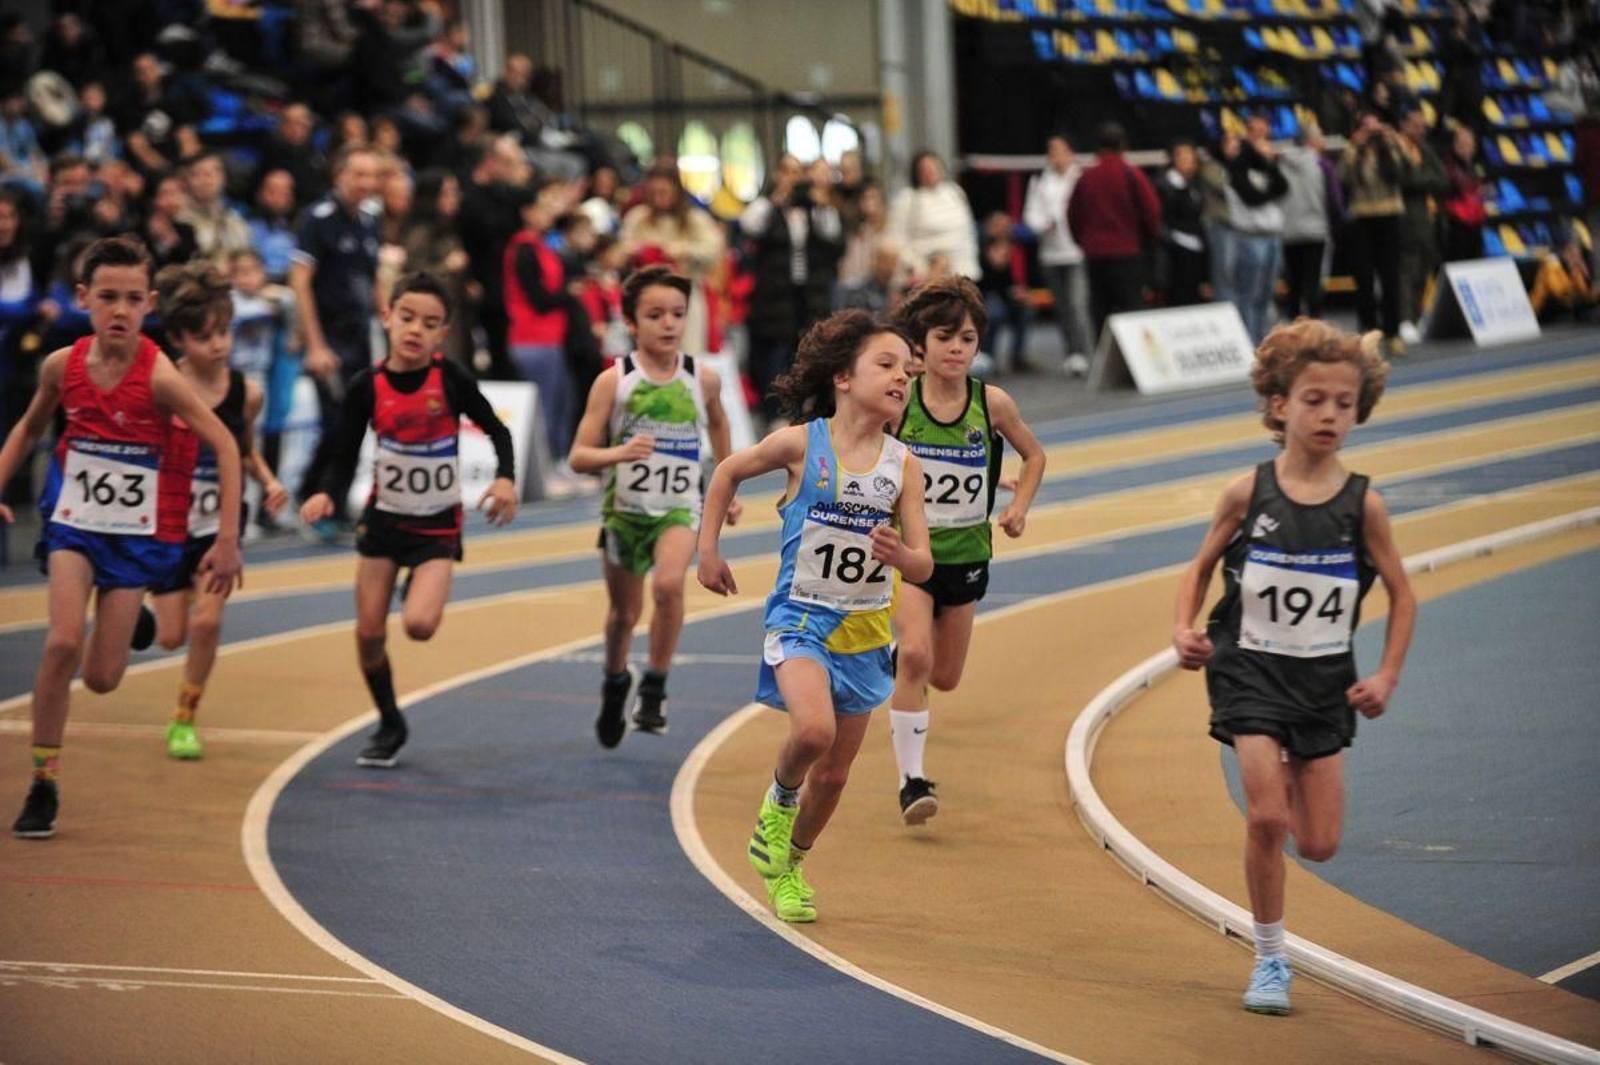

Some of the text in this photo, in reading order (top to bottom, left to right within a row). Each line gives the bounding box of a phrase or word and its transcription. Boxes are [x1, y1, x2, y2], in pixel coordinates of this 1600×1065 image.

[75, 469, 145, 508] 163
[384, 463, 455, 494] 200
[629, 463, 690, 494] 215
[810, 509, 875, 528] OURENSE
[1250, 550, 1319, 565] OURENSE
[1257, 585, 1344, 626] 194
